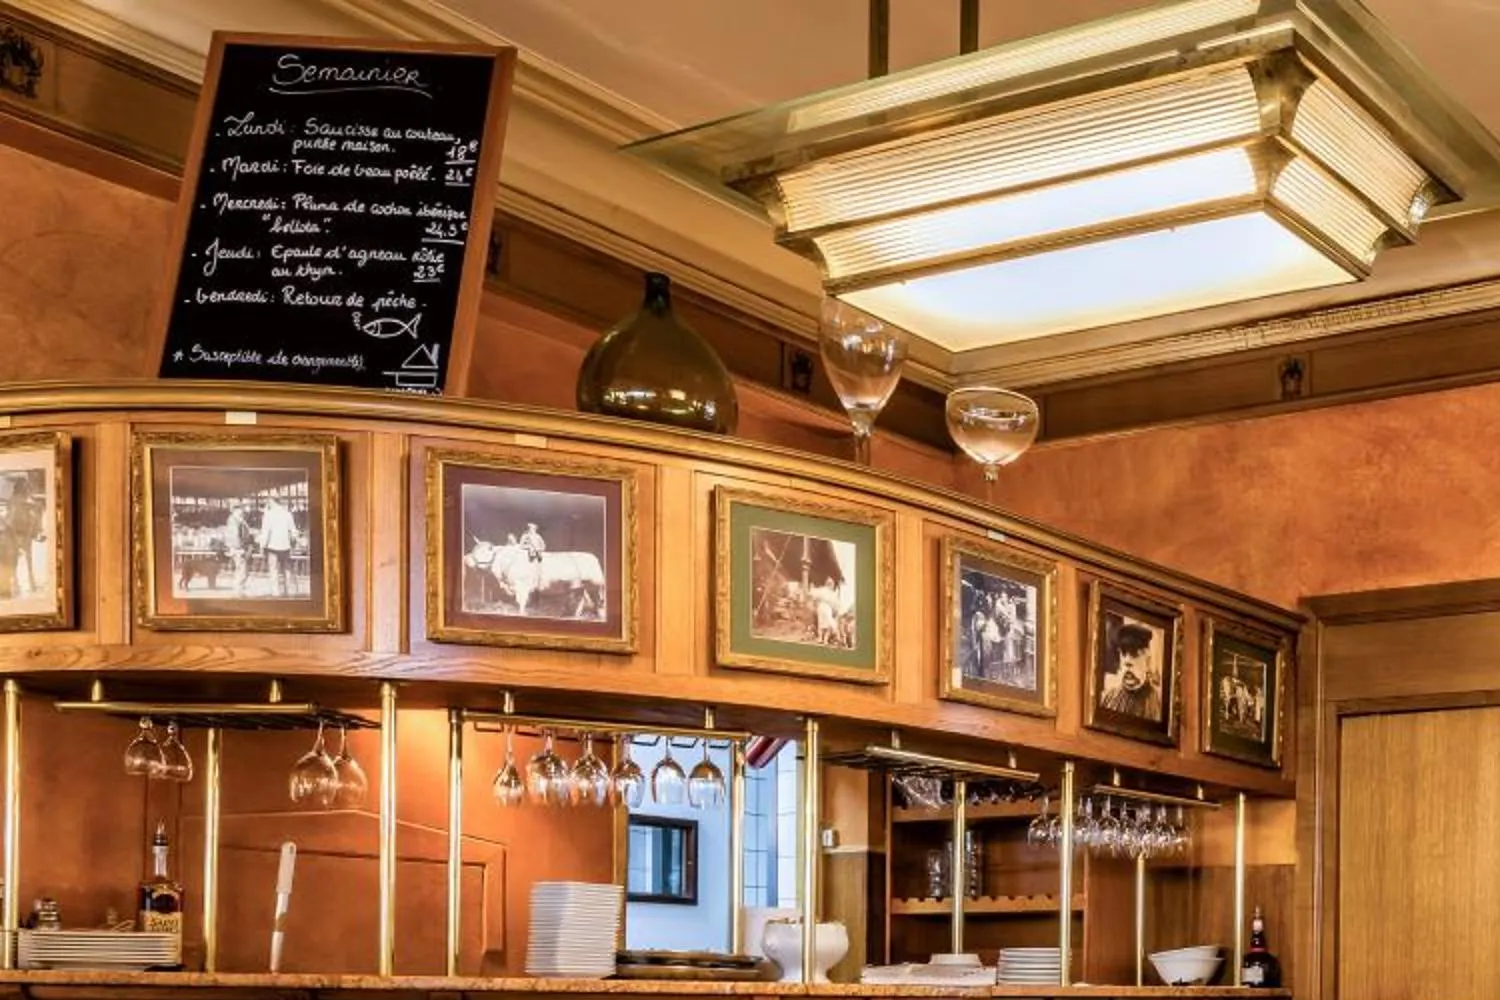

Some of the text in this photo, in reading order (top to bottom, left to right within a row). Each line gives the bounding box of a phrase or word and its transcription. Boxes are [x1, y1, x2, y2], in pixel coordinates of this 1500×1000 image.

[274, 52, 430, 86] Semainier
[382, 127, 403, 139] au
[291, 159, 325, 175] Foie
[327, 163, 351, 177] de
[342, 199, 366, 213] de
[271, 267, 293, 278] au
[281, 284, 343, 307] Retour
[345, 291, 365, 308] de
[266, 349, 289, 367] de
